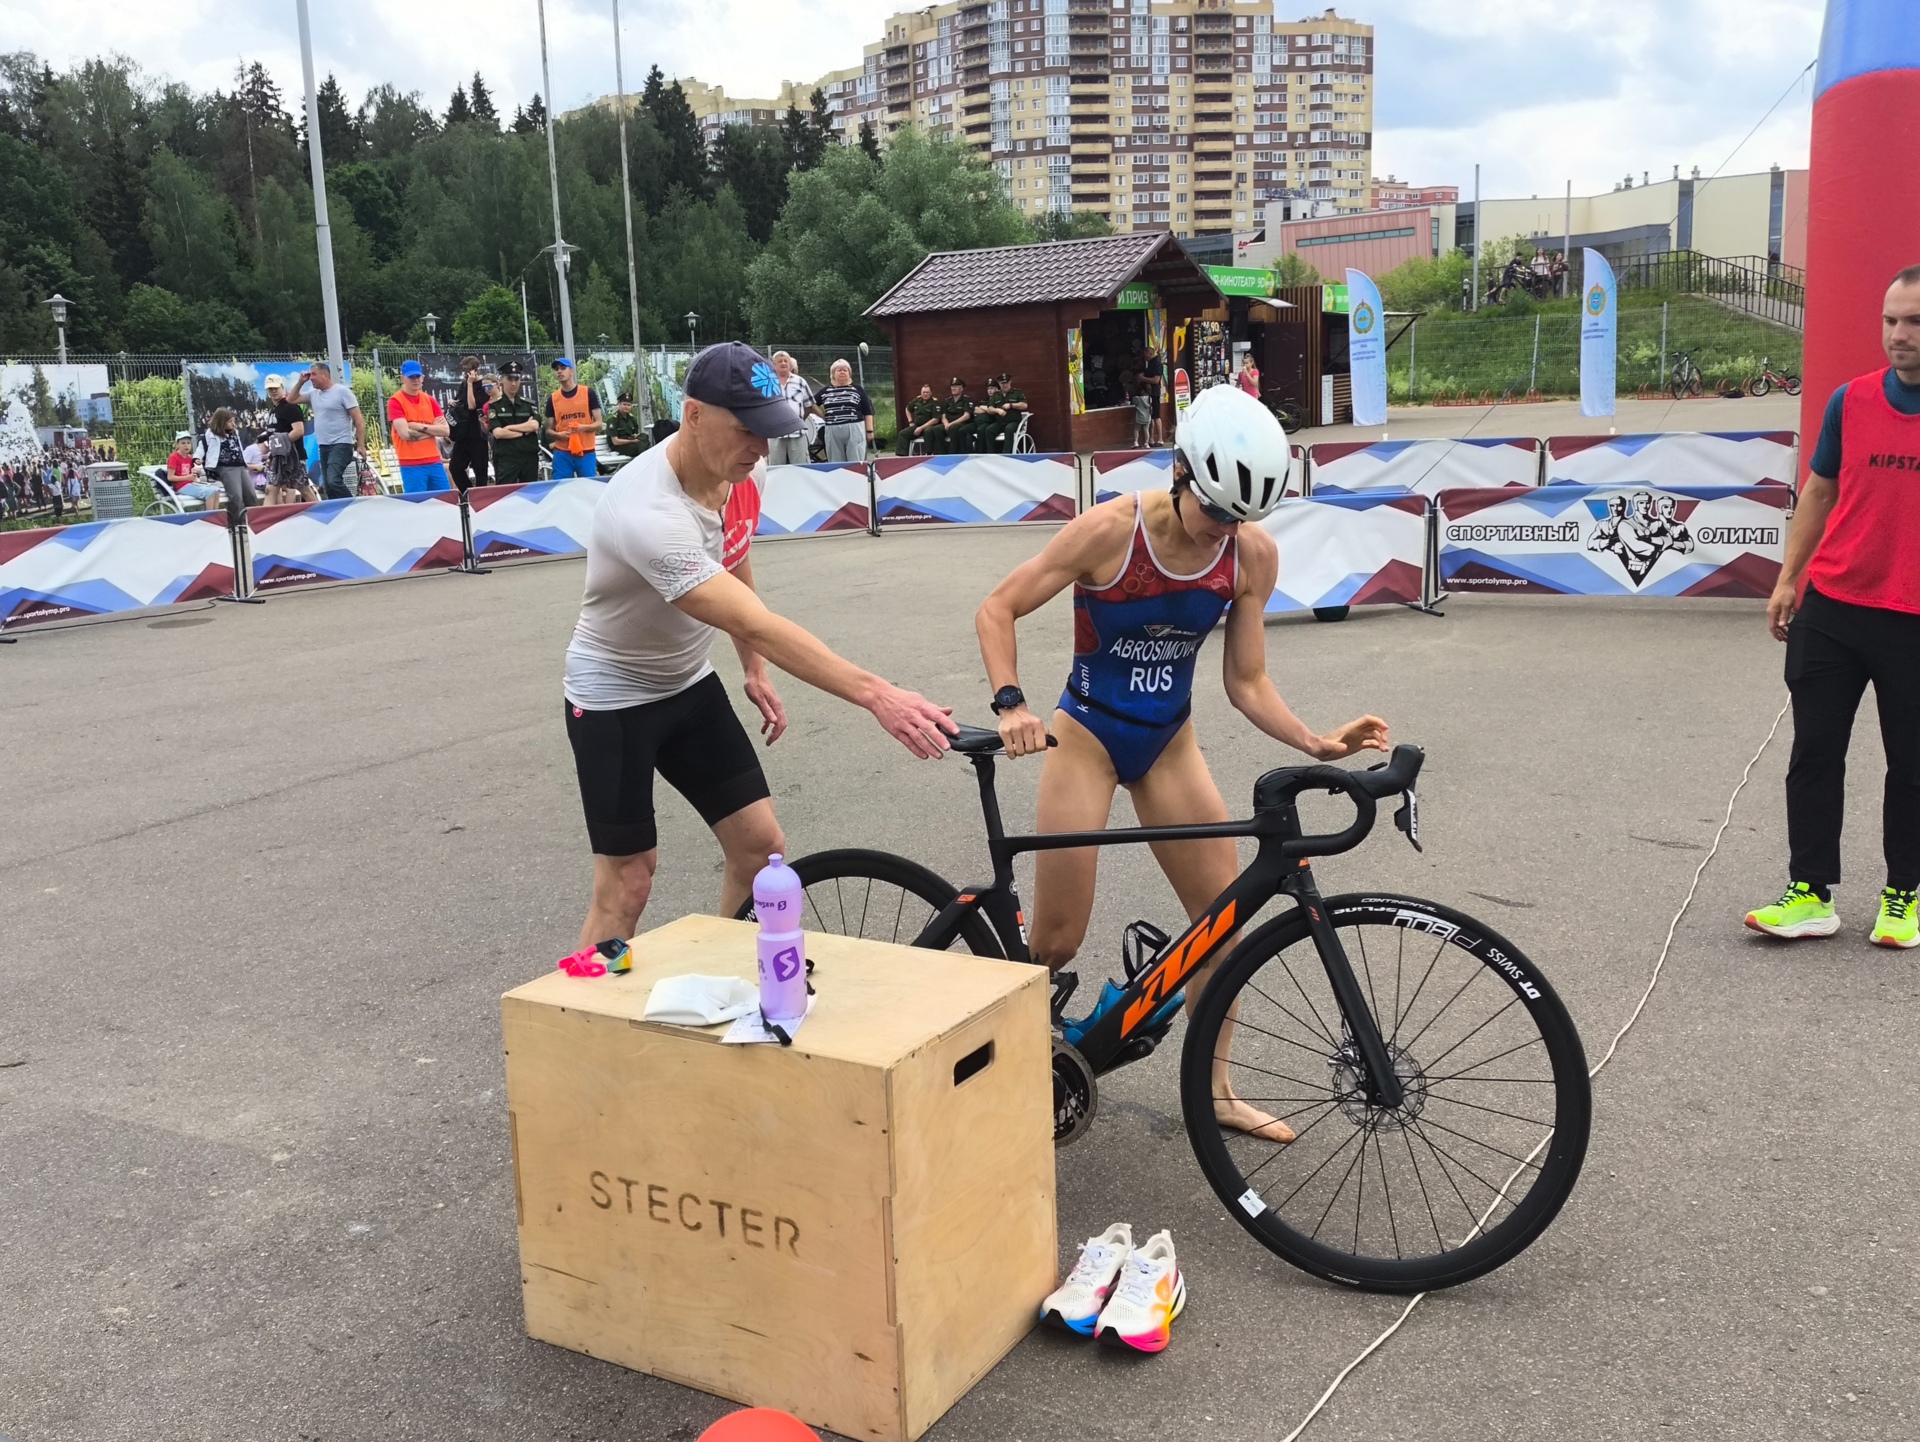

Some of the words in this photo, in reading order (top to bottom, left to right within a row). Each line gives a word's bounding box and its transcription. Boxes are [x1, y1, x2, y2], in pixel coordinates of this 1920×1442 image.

[1126, 290, 1149, 304] ПРИЗ
[1447, 522, 1579, 541] СПОРТИВНЫЙ
[1697, 527, 1779, 544] ОЛИМП
[1446, 577, 1528, 586] www.sportolymp.pro
[5, 606, 71, 622] www.sportolymp.pro
[1109, 637, 1196, 661] ABROSIMOVA
[1129, 665, 1173, 693] RUS
[1360, 897, 1438, 913] CONTINENTAL
[1120, 898, 1236, 1040] KTM
[1486, 948, 1525, 980] SWISS
[1518, 981, 1542, 1000] DT
[590, 1170, 800, 1258] STECTER
